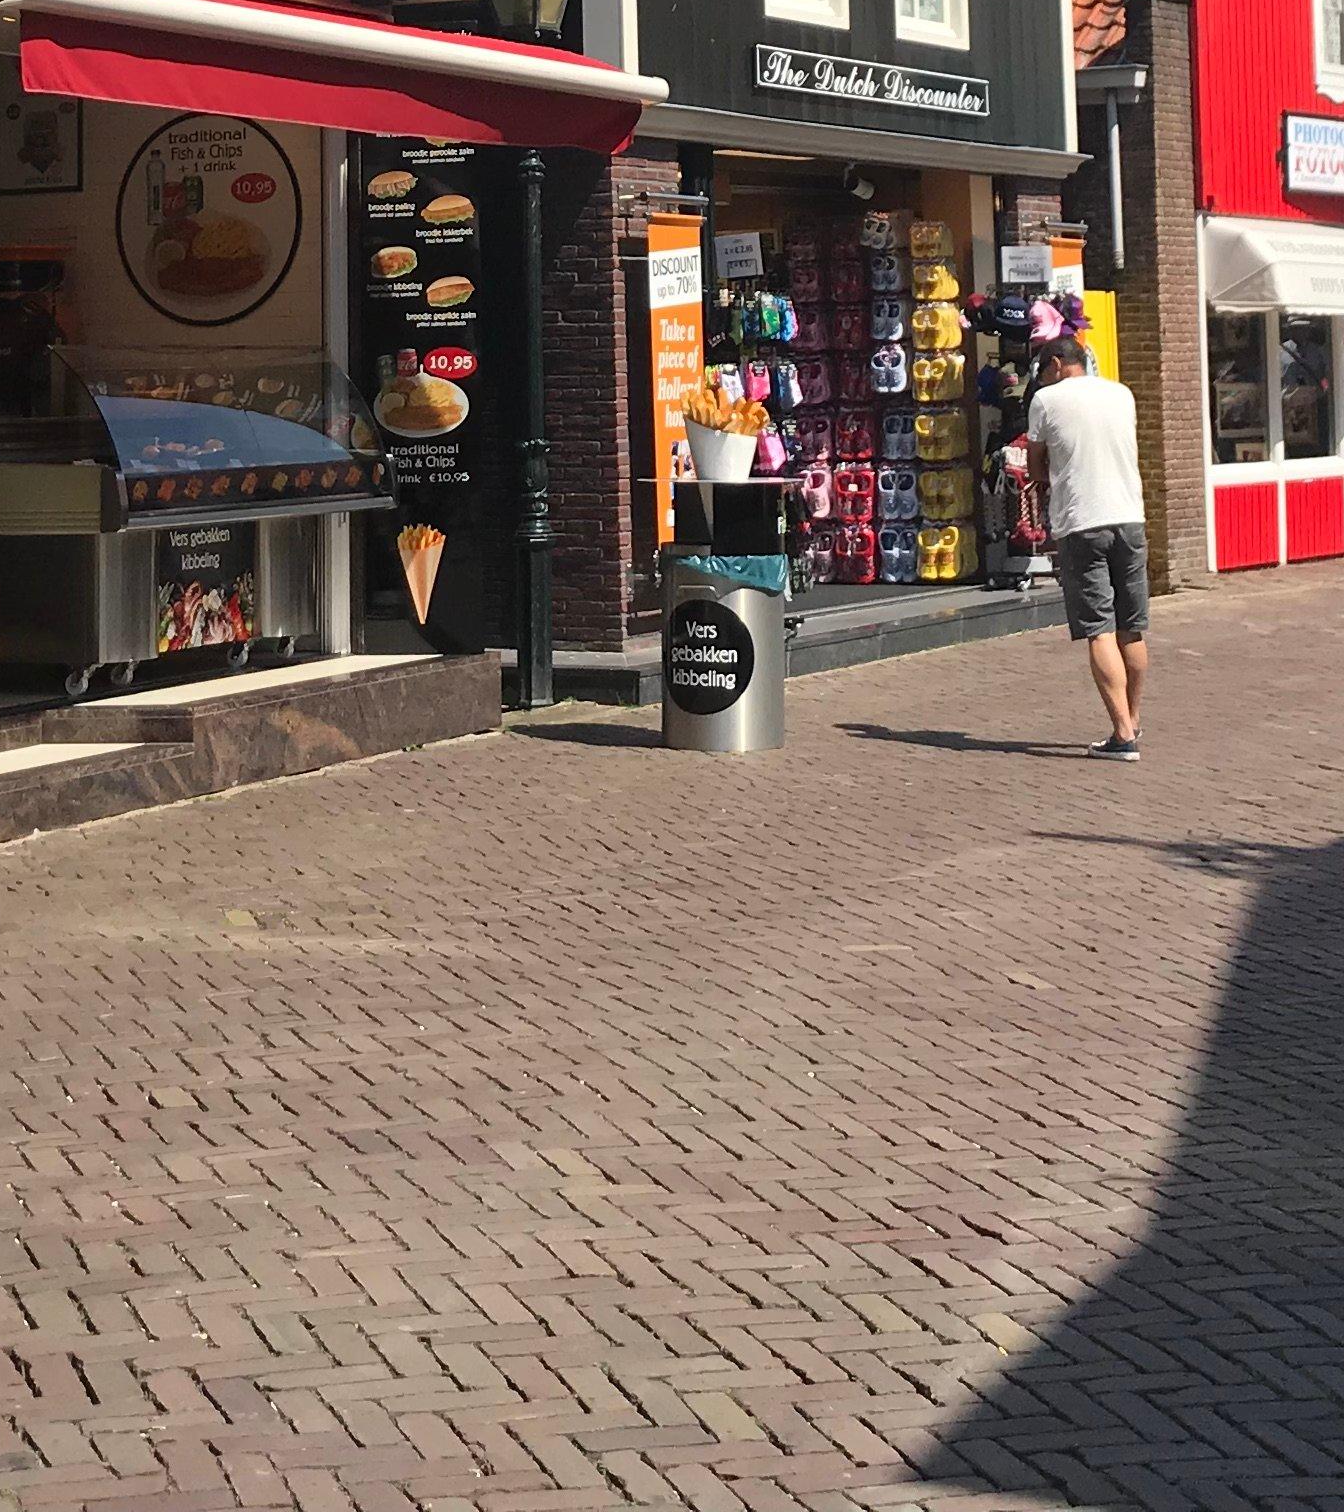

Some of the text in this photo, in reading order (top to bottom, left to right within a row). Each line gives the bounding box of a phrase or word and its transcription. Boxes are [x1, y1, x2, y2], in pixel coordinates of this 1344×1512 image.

[763, 51, 984, 111] The Dutch Discounter
[168, 127, 247, 144] traditional
[171, 147, 194, 161] Fish
[209, 144, 243, 159] Chips
[203, 161, 236, 173] drink
[235, 180, 272, 195] 10,95
[653, 255, 698, 276] DISCOUNT
[657, 275, 697, 299] up to 70%
[659, 317, 695, 342] Take a
[430, 356, 473, 371] 10,95
[658, 345, 699, 373] piece of
[390, 443, 459, 455] traditional
[415, 459, 422, 468] &
[426, 456, 455, 468] Chips
[170, 526, 230, 548] Vers gebakken
[181, 552, 220, 571] kibbeling
[686, 621, 718, 638] Vers
[671, 645, 737, 666] gebakken
[672, 668, 736, 690] kibbeling
